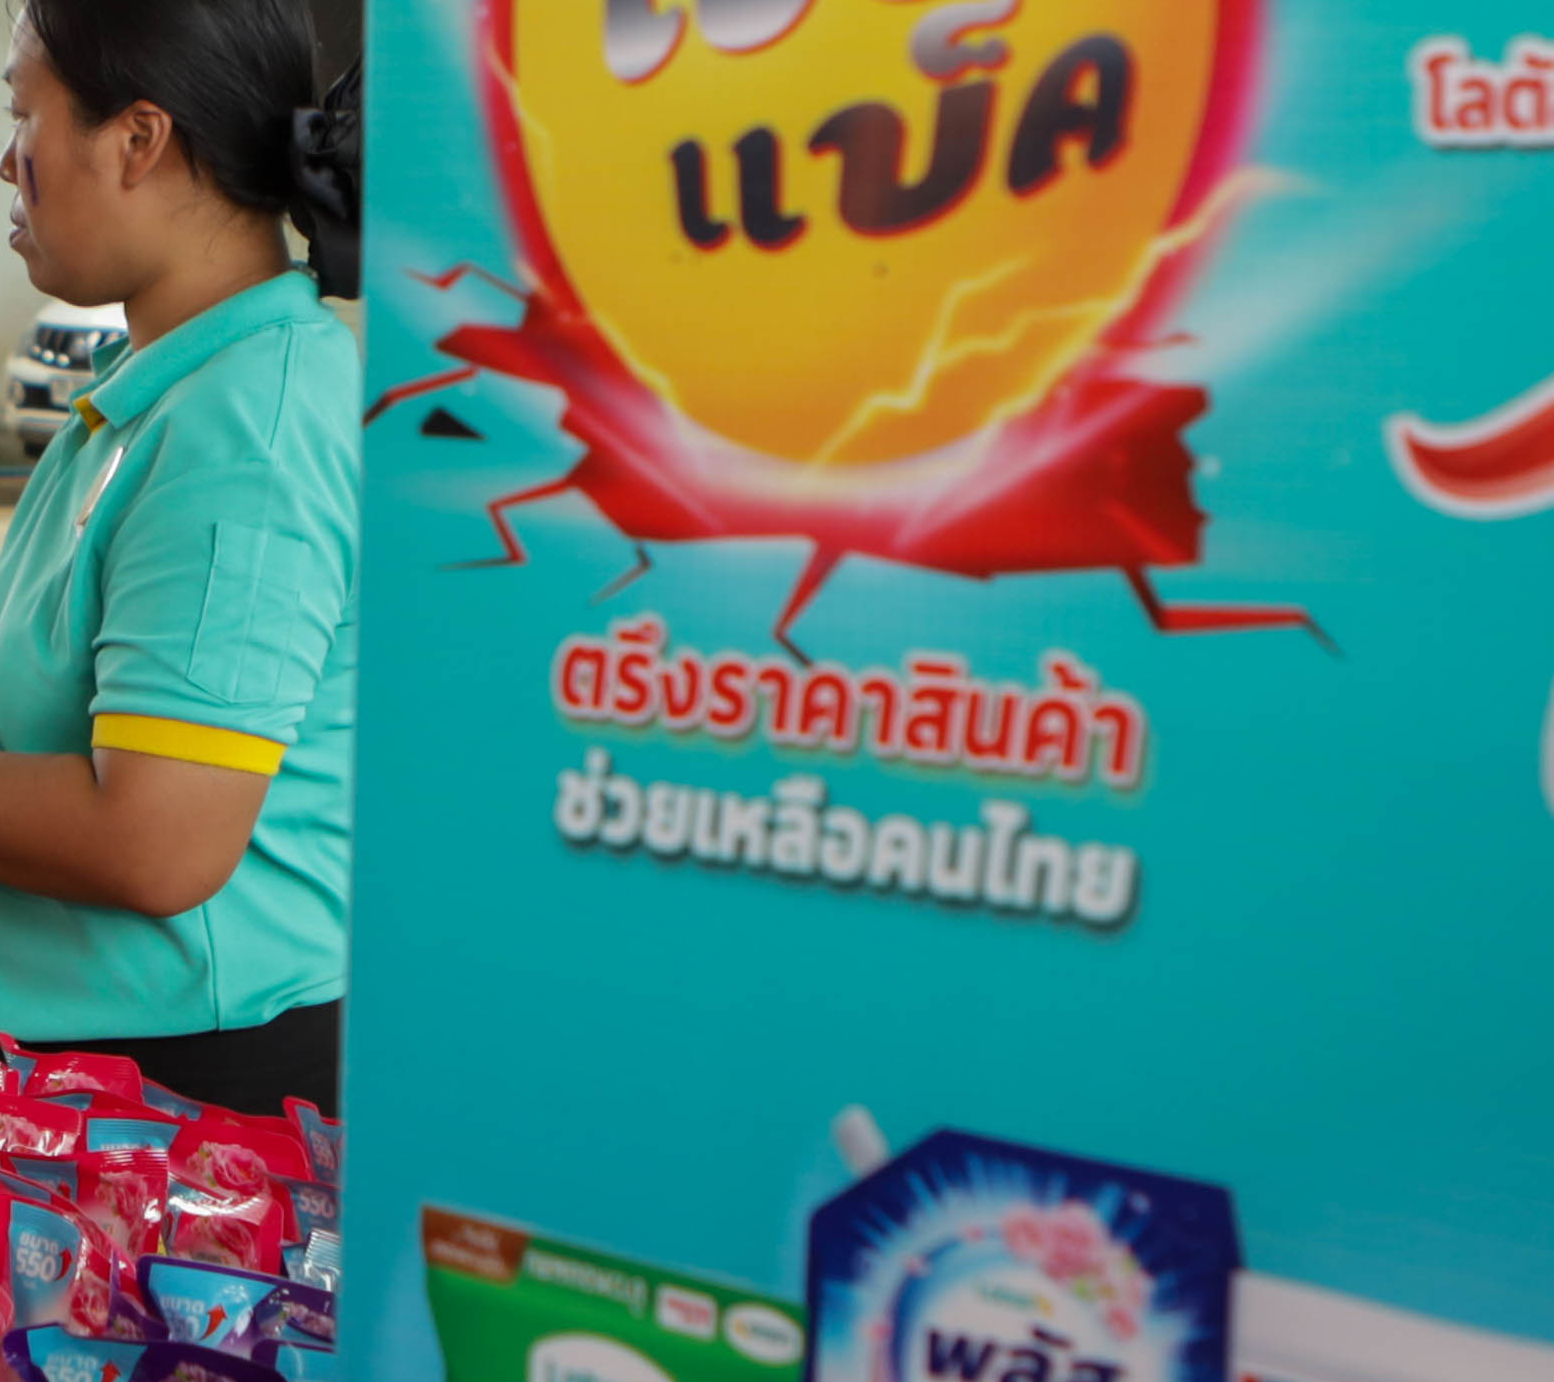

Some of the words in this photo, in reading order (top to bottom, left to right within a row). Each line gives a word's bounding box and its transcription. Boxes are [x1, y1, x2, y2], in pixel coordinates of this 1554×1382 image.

[556, 618, 1144, 784] ตรึงราคาสินค้า
[555, 749, 1137, 922] ช่วยเหลือคนไทย
